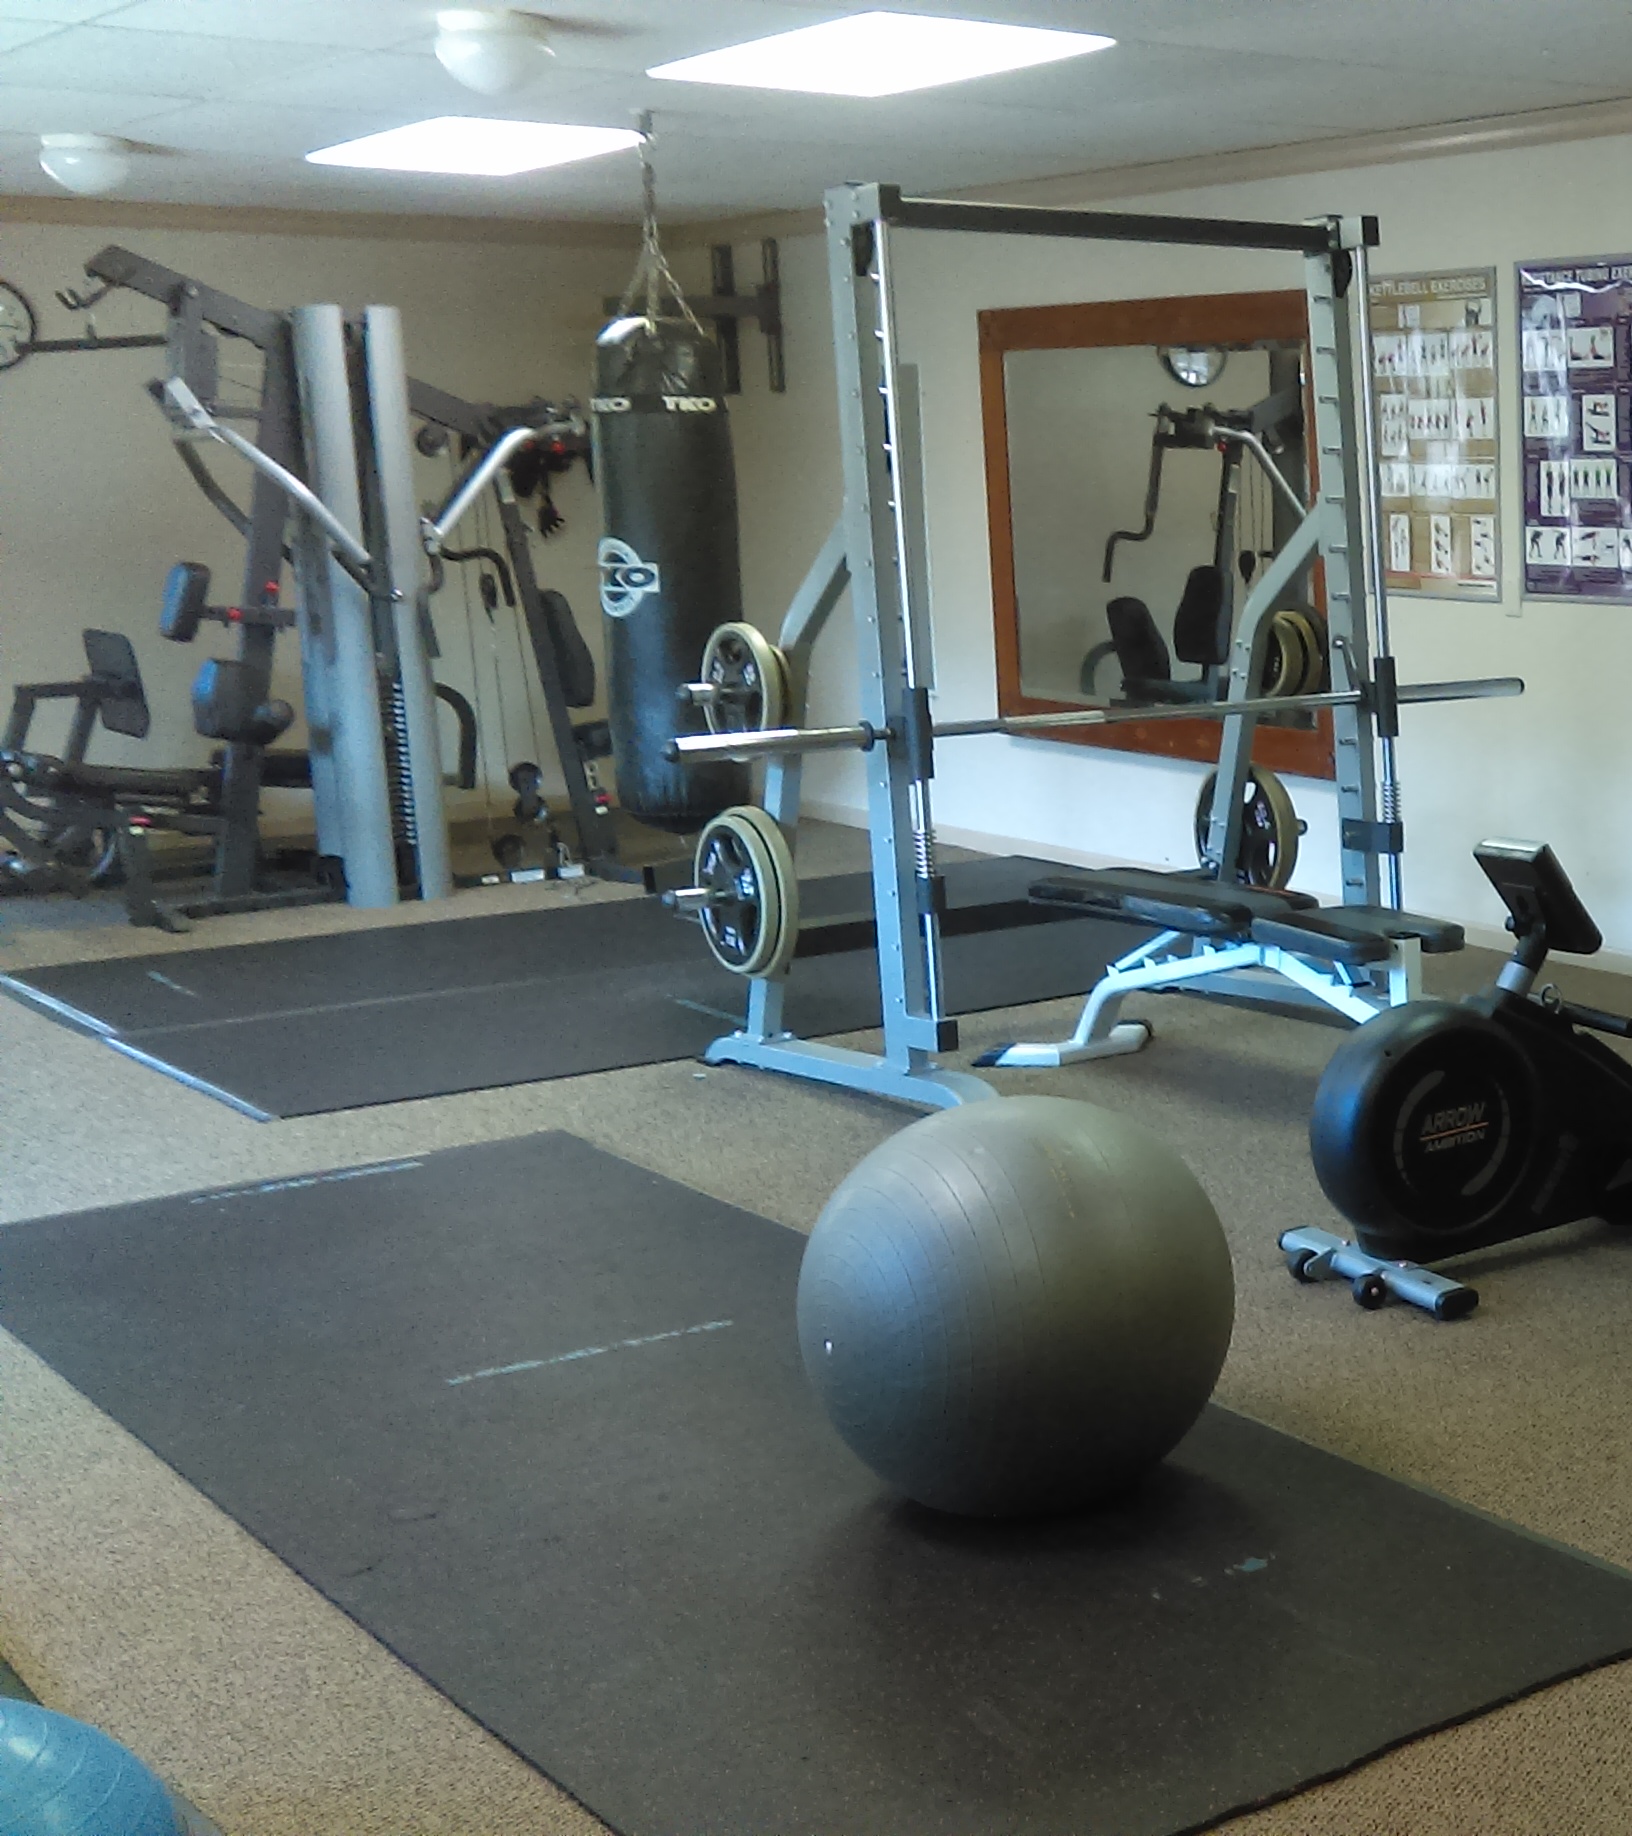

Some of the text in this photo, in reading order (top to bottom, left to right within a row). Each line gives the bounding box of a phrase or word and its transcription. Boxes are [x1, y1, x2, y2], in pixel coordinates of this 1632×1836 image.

[661, 395, 718, 412] TKO
[1421, 1101, 1486, 1136] ARROW
[1424, 1128, 1486, 1153] AMBITION
